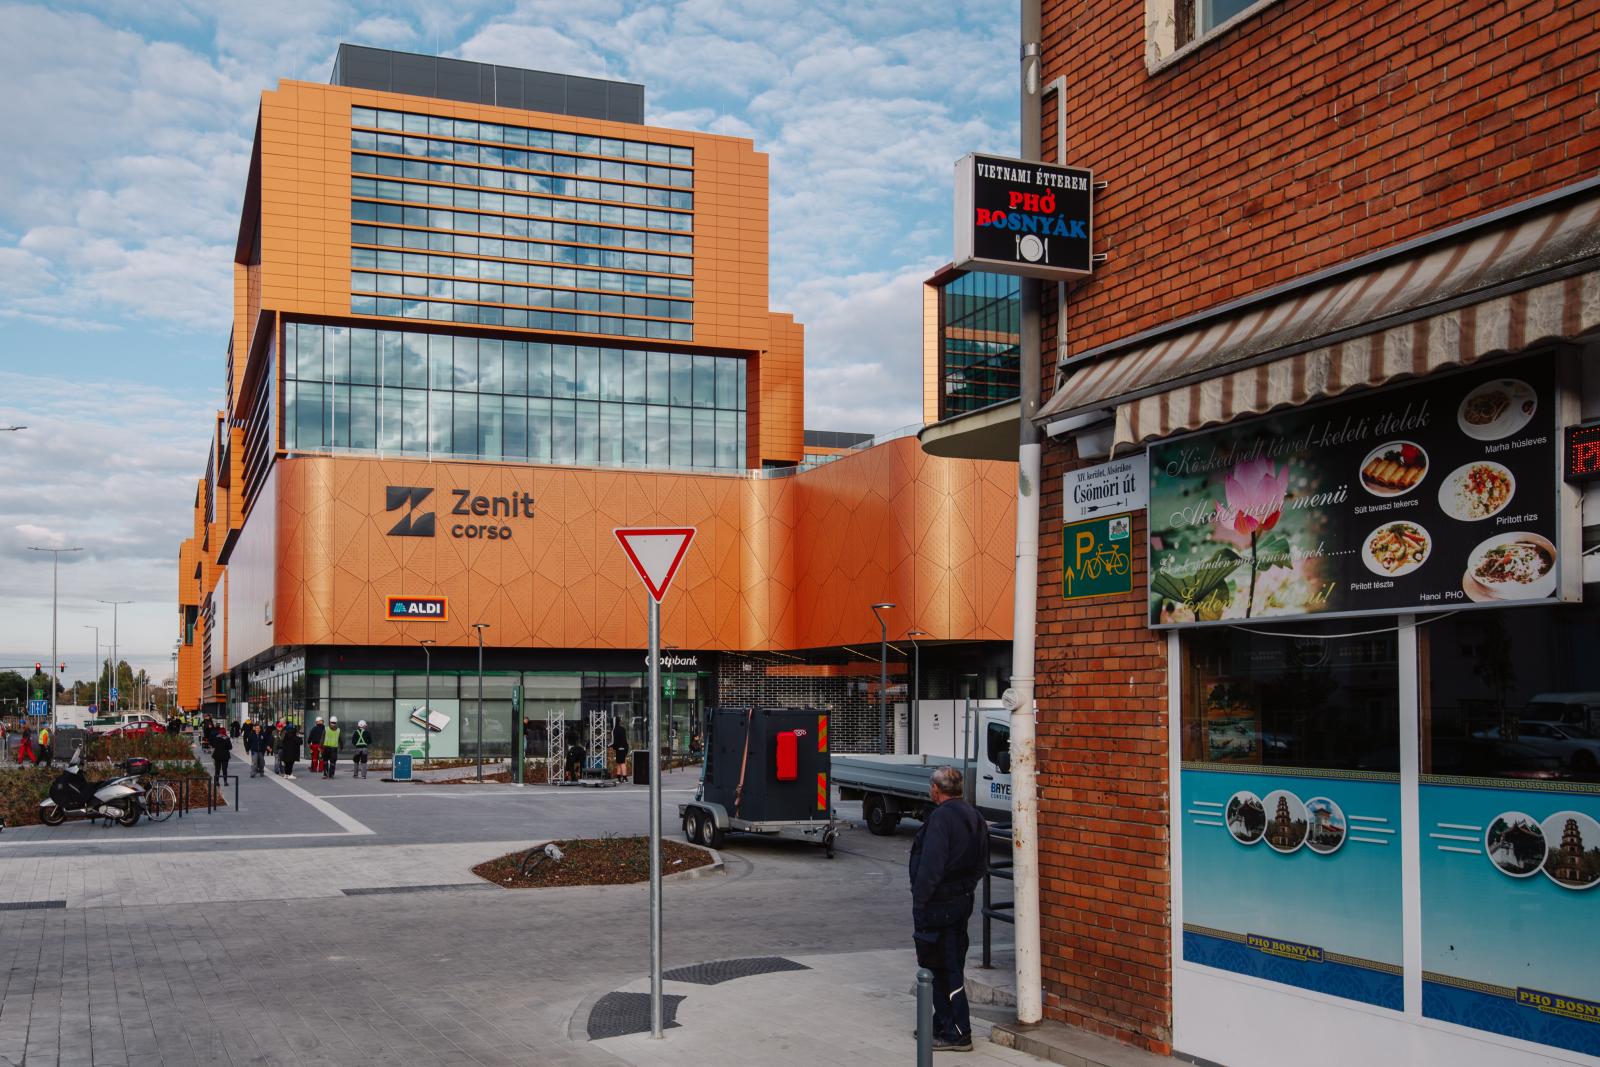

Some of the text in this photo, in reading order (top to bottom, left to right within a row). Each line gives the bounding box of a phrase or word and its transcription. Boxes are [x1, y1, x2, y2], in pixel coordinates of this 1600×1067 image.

[977, 163, 1087, 191] VIETNAMI ÉTTEREM
[975, 207, 1087, 239] BOSNYÁK
[1374, 399, 1430, 436] ételek
[1485, 436, 1547, 454] Marha húsleves
[1073, 473, 1136, 504] Csömöri út
[1292, 484, 1348, 509] menü
[451, 489, 535, 518] Zenit
[1354, 499, 1419, 515] Sült tavaszi tekercs
[1523, 513, 1538, 522] rizs
[451, 523, 513, 540] corso
[1076, 531, 1095, 570] P
[1419, 590, 1464, 601] Hanoi PHO
[408, 603, 441, 614] ALDI
[1249, 936, 1269, 948] PHO
[1273, 941, 1320, 958] BOSNYÁK
[1520, 991, 1552, 1006] PHO
